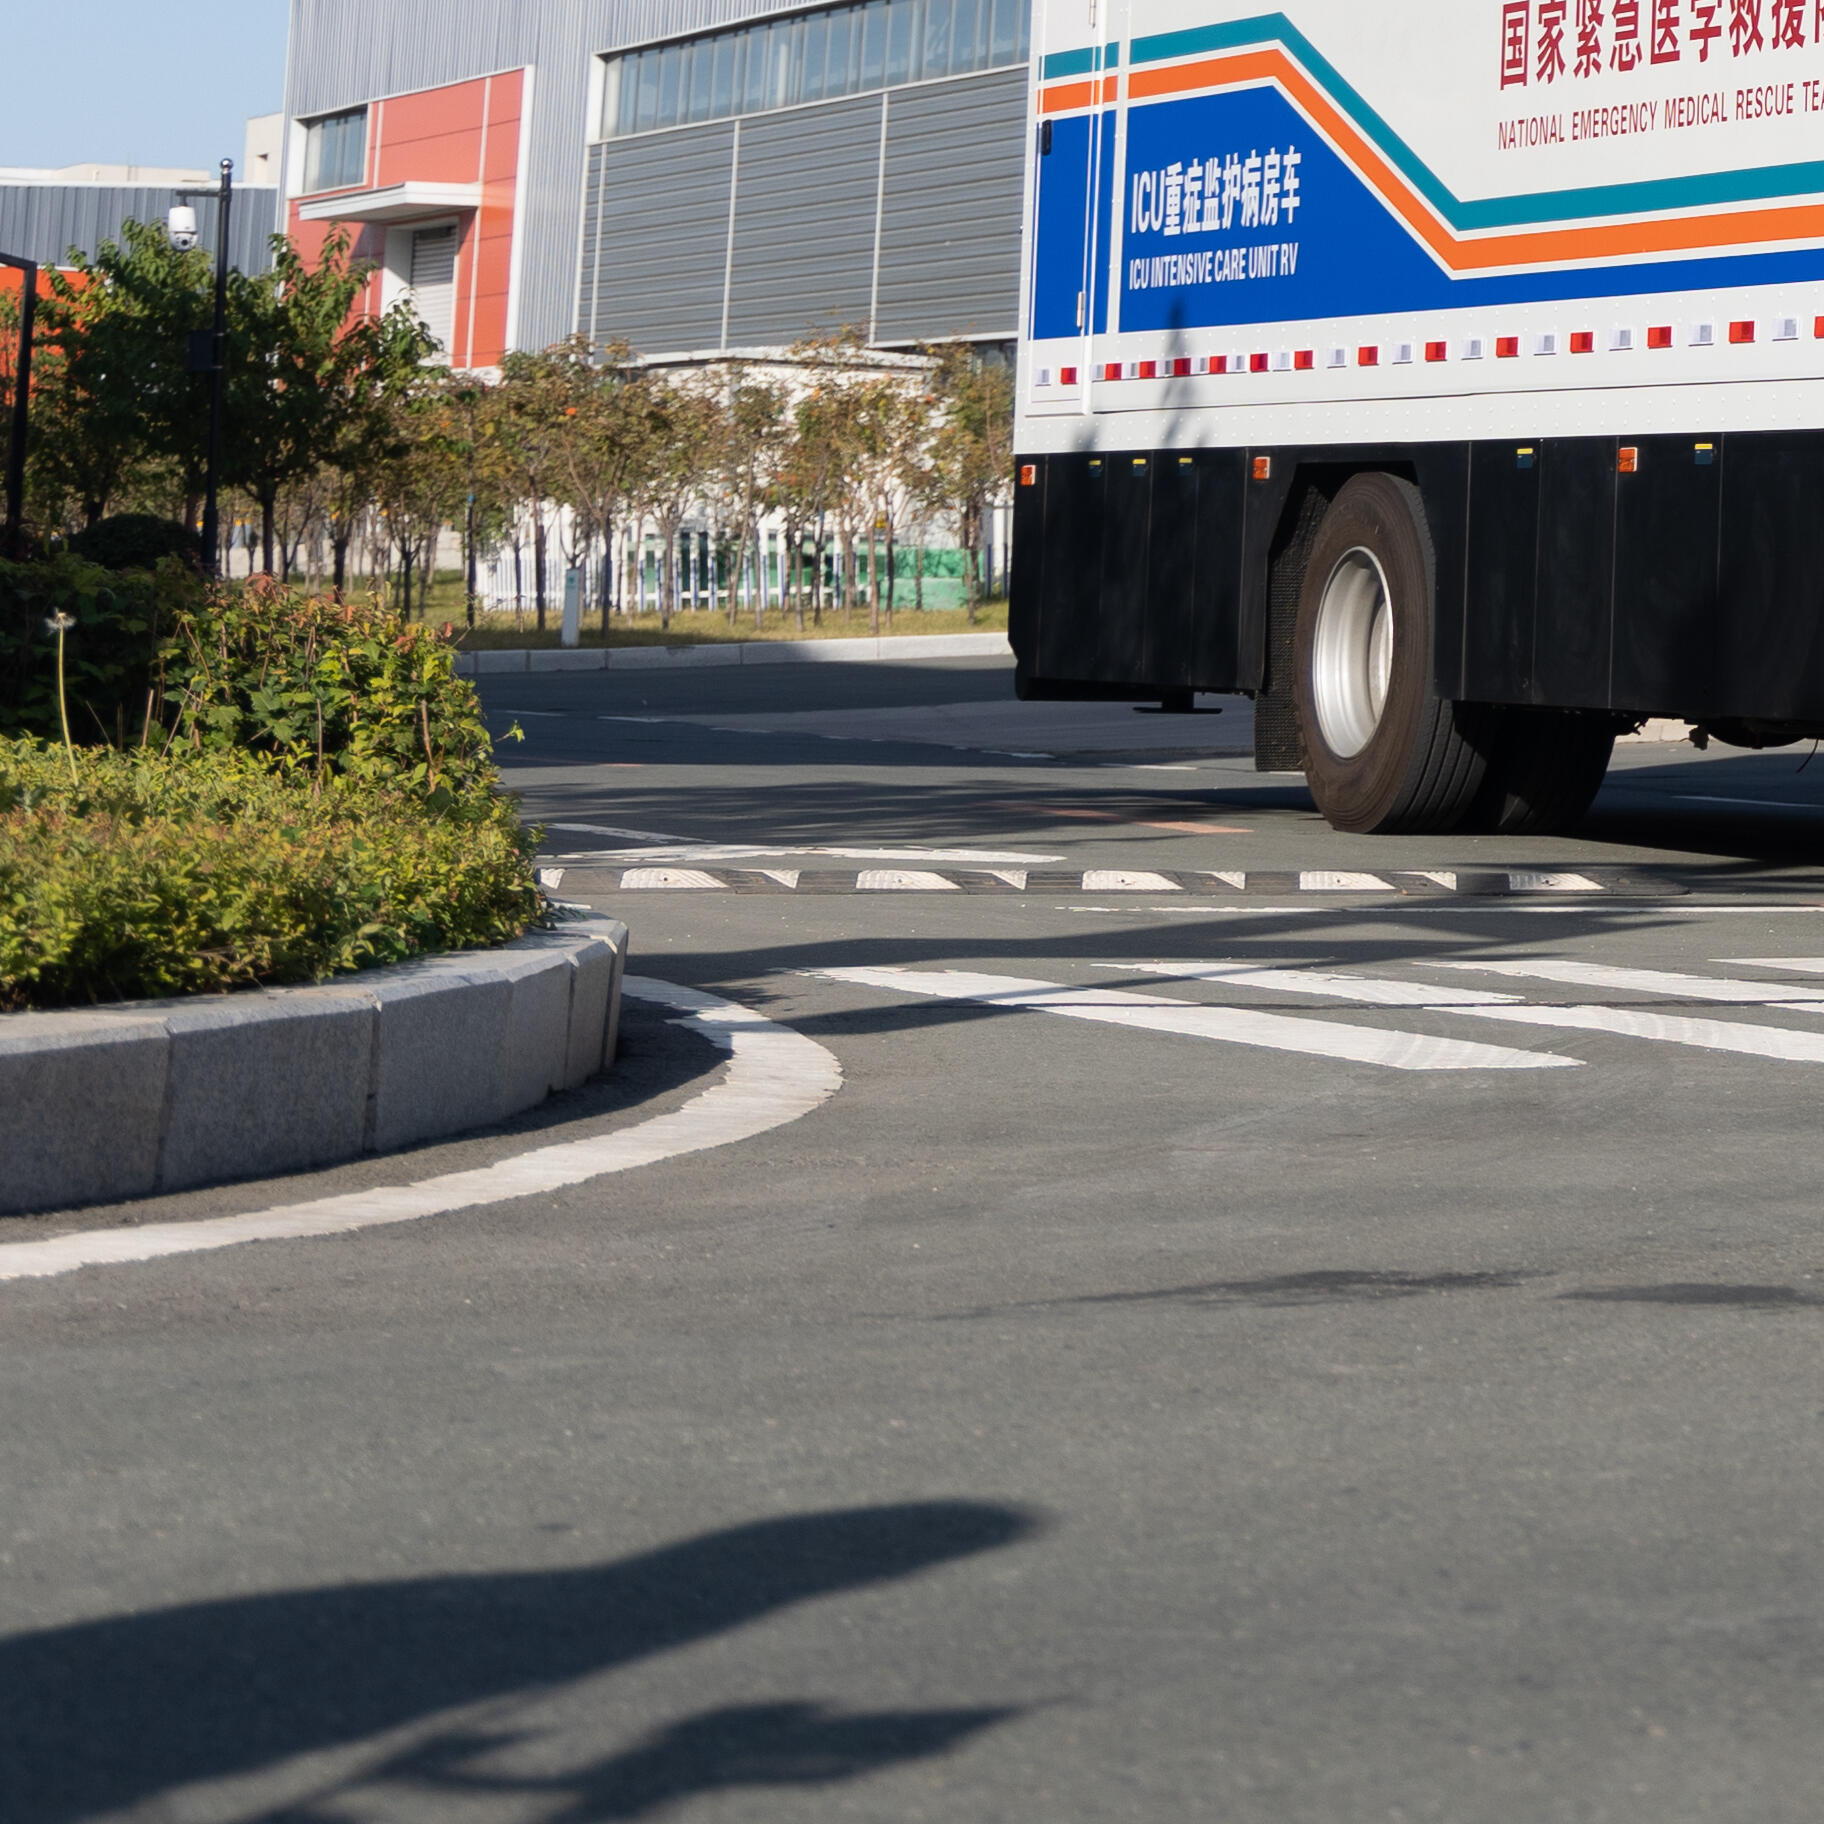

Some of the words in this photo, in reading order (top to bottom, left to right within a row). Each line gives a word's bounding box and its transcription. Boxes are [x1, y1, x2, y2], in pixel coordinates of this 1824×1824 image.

[1498, 112, 1565, 150] NATIONAL
[1572, 100, 1658, 141] EMERGENCY
[1664, 91, 1728, 130] MEDICAL
[1736, 82, 1794, 121] RESCUE
[1131, 145, 1302, 236] ICU重症监护病房车
[1129, 258, 1150, 290] ICU
[1150, 251, 1213, 288] INTENSIVE
[1214, 248, 1247, 282] CARE
[1248, 244, 1279, 279] UNIT
[1280, 242, 1299, 276] RV
